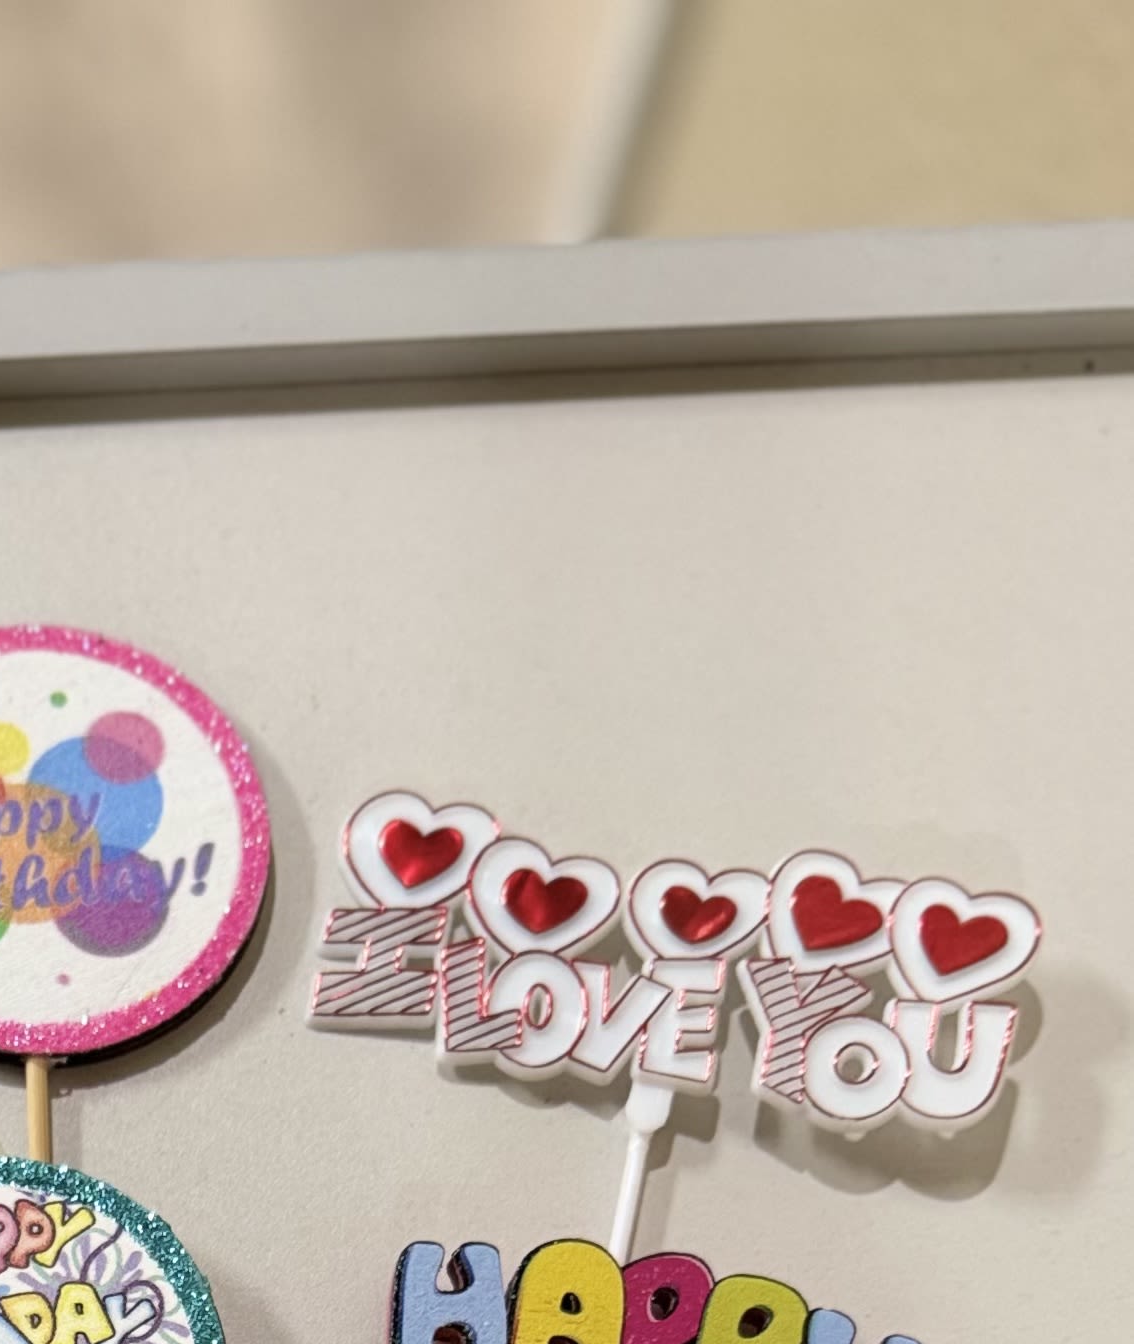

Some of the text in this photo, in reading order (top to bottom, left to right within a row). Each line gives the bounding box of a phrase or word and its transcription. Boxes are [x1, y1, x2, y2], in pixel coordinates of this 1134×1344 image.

[311, 906, 1017, 1122] I LOVE YOU
